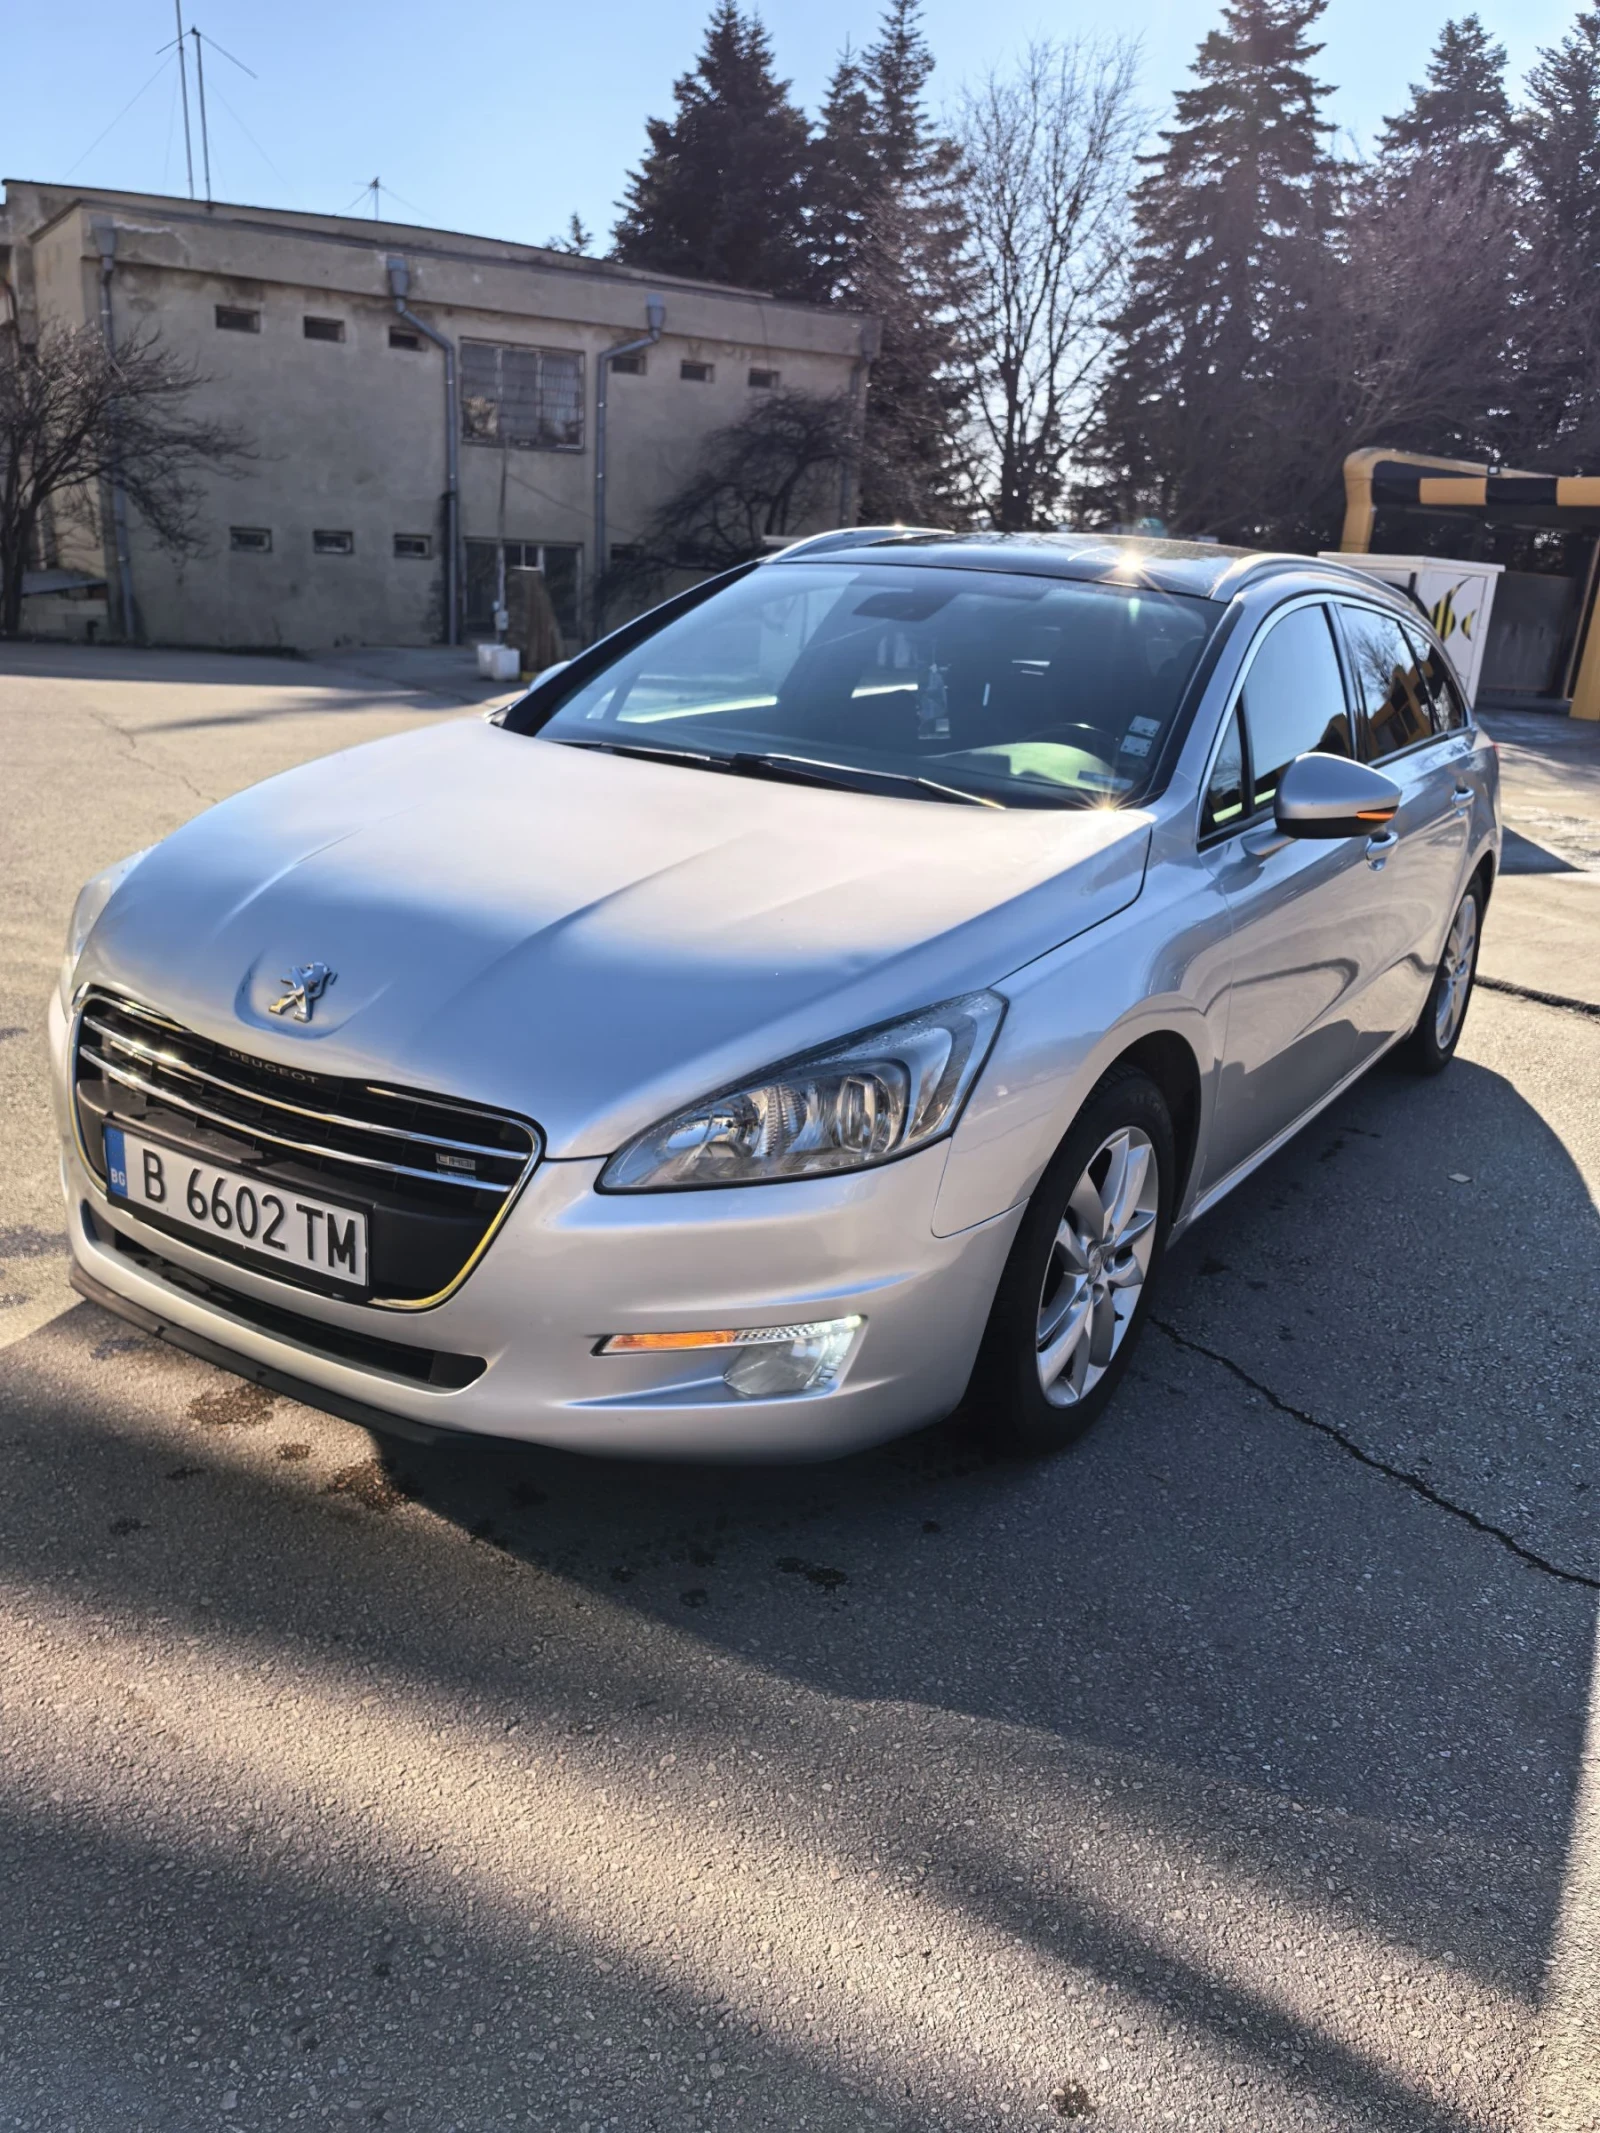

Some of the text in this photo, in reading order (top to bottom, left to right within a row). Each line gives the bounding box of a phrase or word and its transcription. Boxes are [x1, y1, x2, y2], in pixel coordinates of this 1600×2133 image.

[229, 1050, 318, 1084] PEUGEOT
[110, 1168, 126, 1187] BG
[143, 1148, 356, 1274] B 6602 TM
